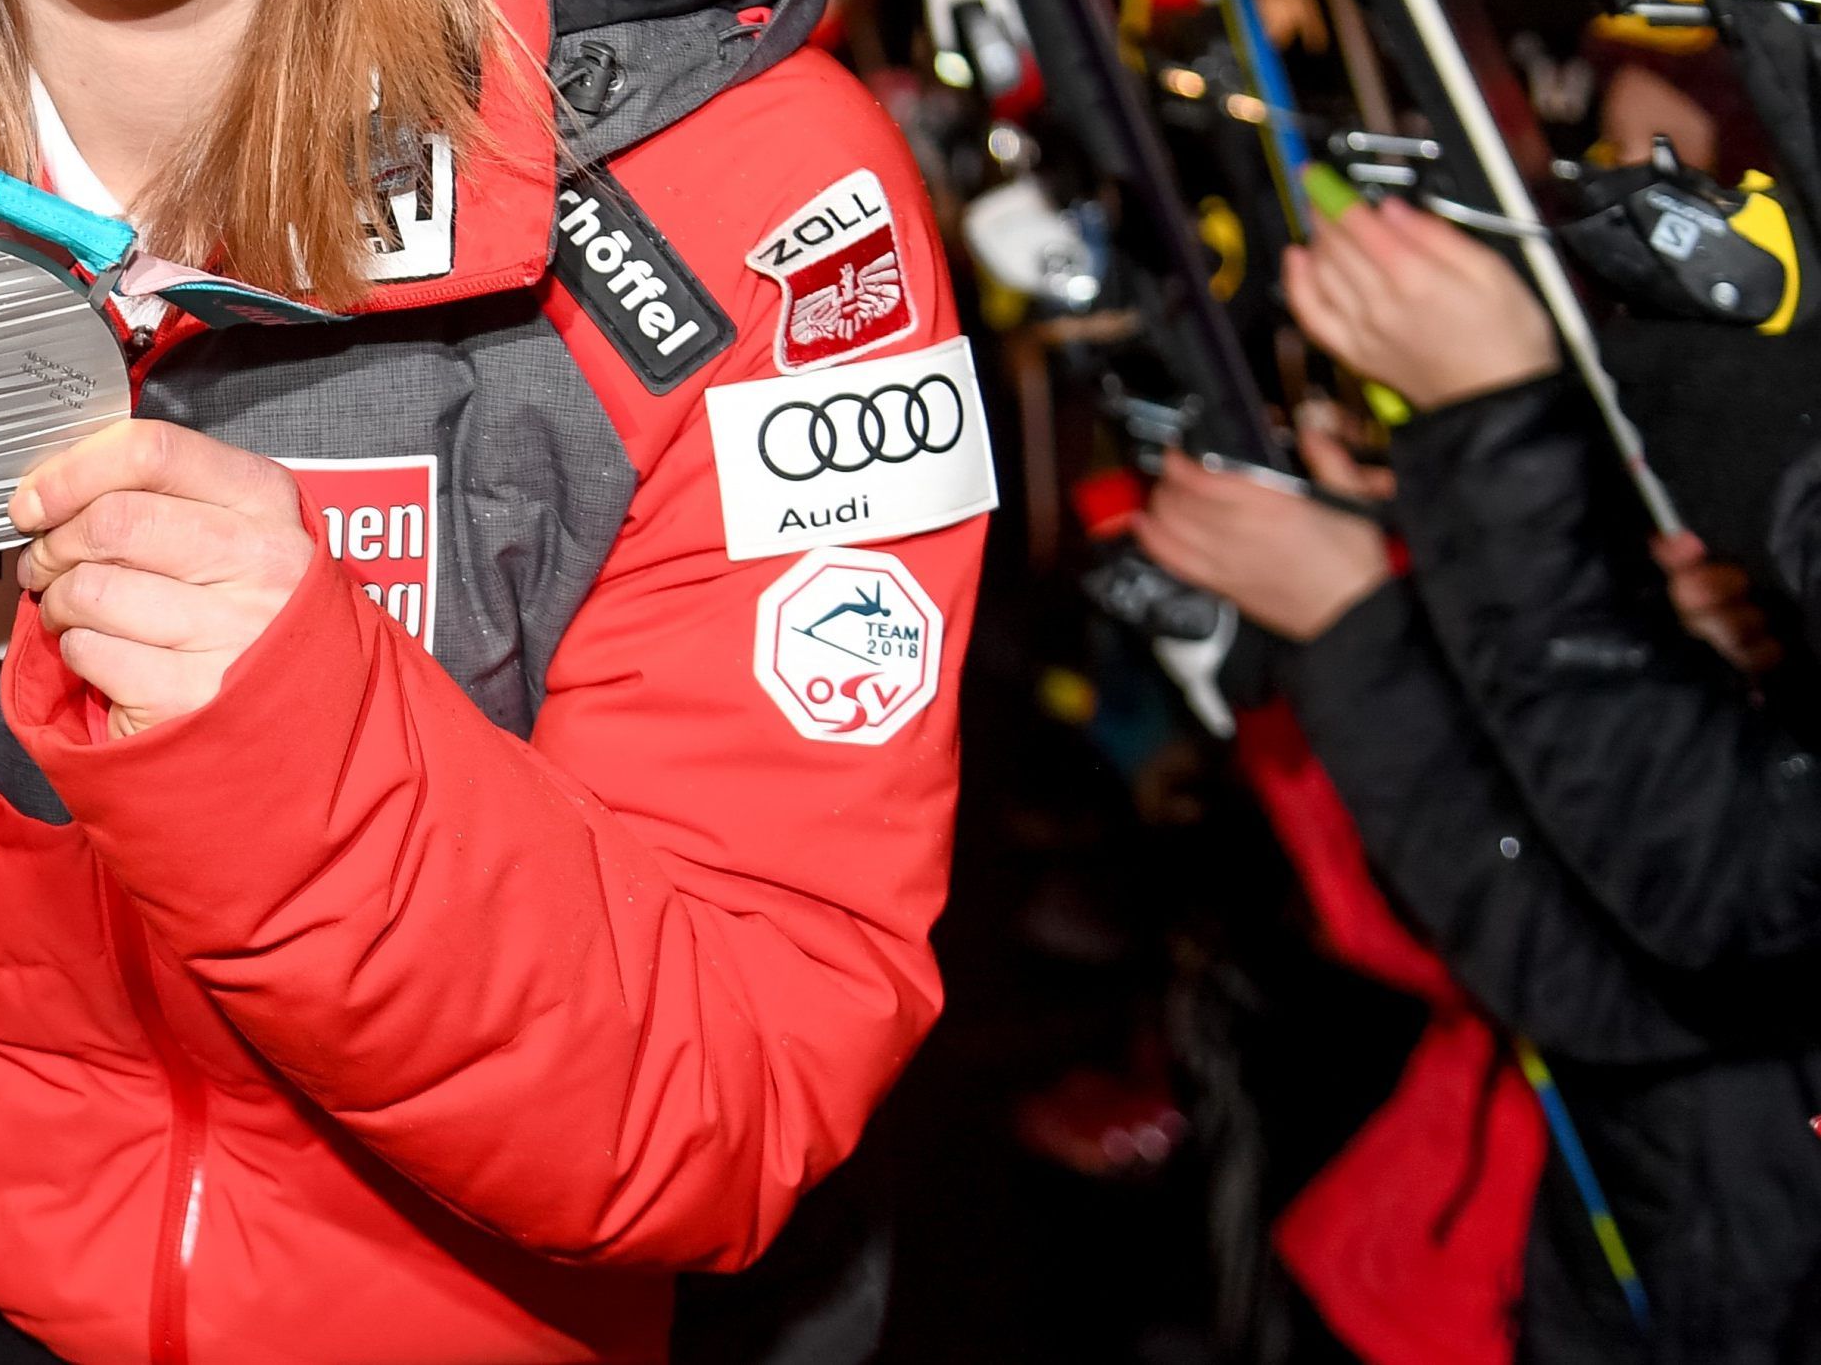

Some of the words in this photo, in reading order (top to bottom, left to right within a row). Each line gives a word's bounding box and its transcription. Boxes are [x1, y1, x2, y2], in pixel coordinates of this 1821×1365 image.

[757, 192, 882, 266] ZOLL
[778, 494, 870, 533] Audi
[865, 621, 920, 642] TEAM
[866, 639, 918, 660] 2018
